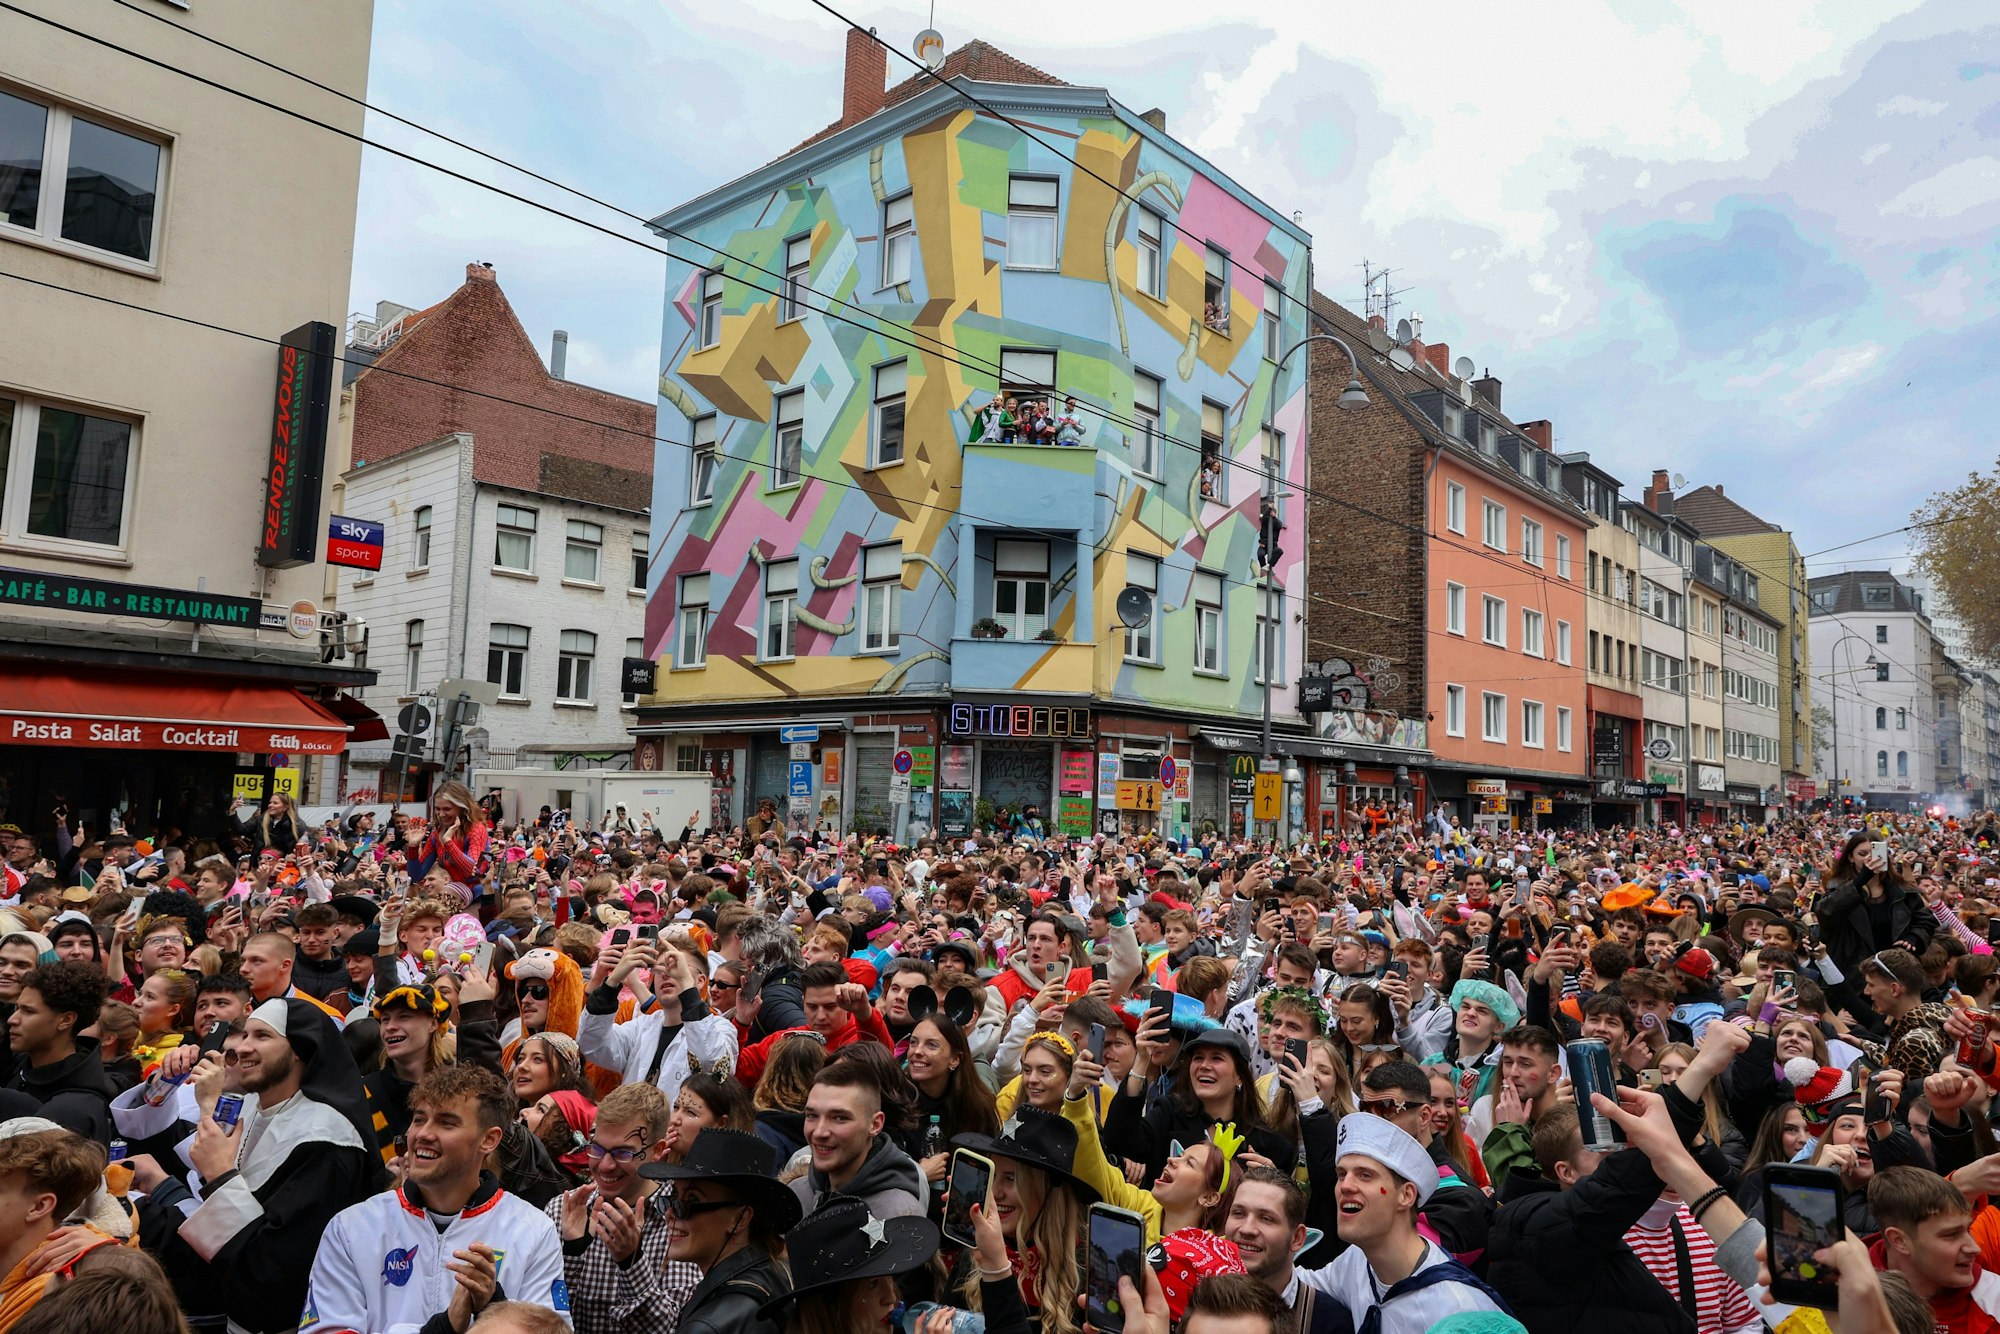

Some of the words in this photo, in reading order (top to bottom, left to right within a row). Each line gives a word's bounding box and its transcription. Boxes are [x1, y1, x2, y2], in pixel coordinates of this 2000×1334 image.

[286, 459, 296, 486] BAR
[291, 354, 304, 445] RESTAURANT
[265, 346, 296, 549] RENDEZVOUS
[341, 522, 370, 541] sky
[336, 547, 370, 560] sport
[67, 587, 106, 608] BAR
[126, 594, 250, 622] RESTAURANT
[954, 705, 1088, 734] STIEFEL
[12, 720, 72, 739] Pasta
[89, 724, 141, 742] Salat
[162, 727, 239, 746] Cocktail
[269, 734, 300, 750] früh
[793, 765, 803, 778] P
[1262, 778, 1275, 789] U1
[1649, 787, 1664, 795] sky
[655, 806, 660, 816] 3
[387, 1260, 411, 1271] NASA
